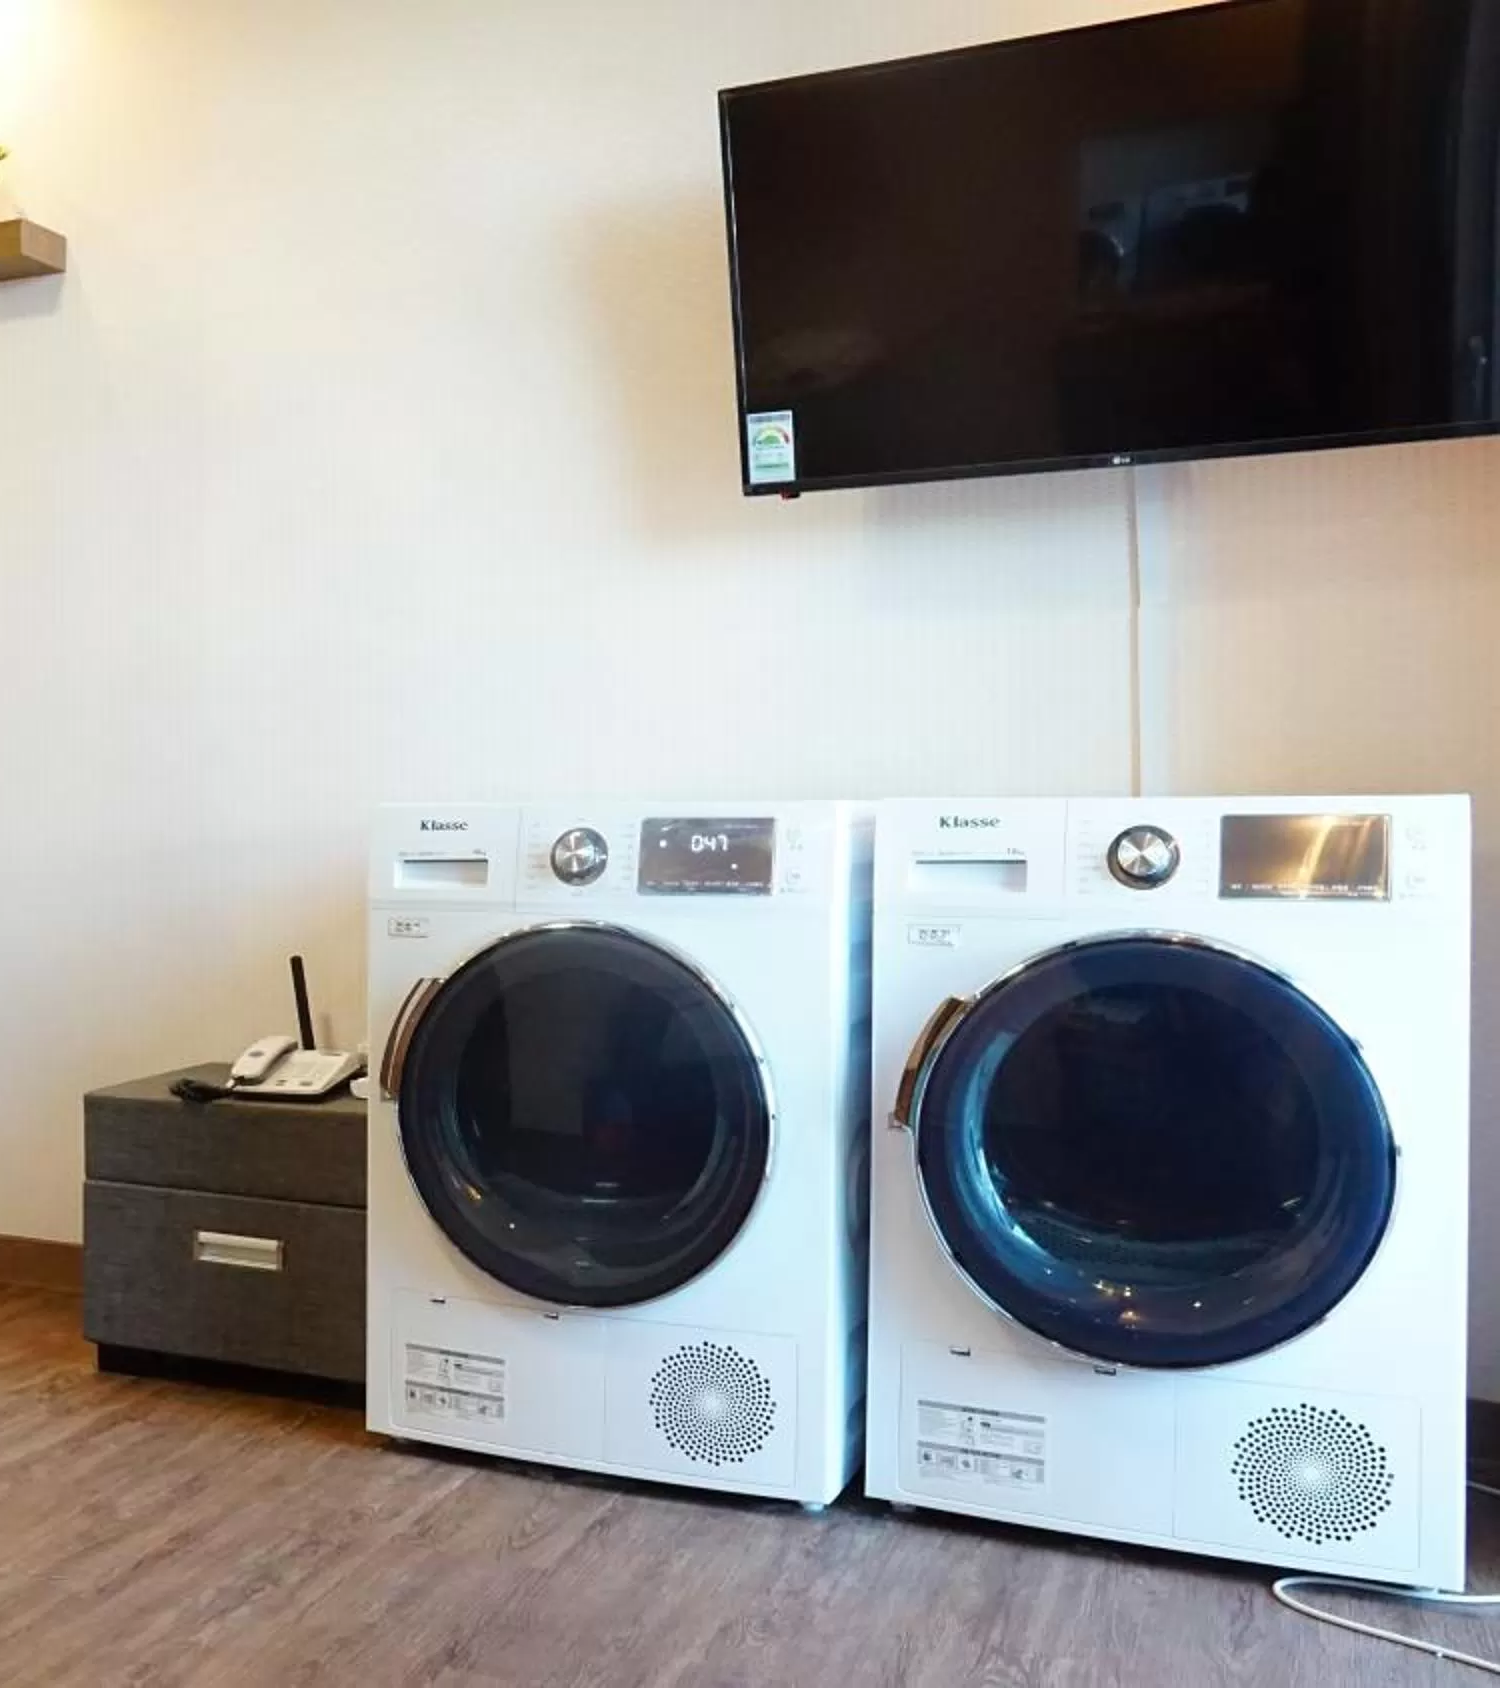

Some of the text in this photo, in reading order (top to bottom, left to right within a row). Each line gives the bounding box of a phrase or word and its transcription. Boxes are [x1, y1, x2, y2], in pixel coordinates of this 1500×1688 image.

[420, 819, 468, 831] Klasse
[939, 815, 1001, 829] Klasse
[691, 833, 729, 852] 047
